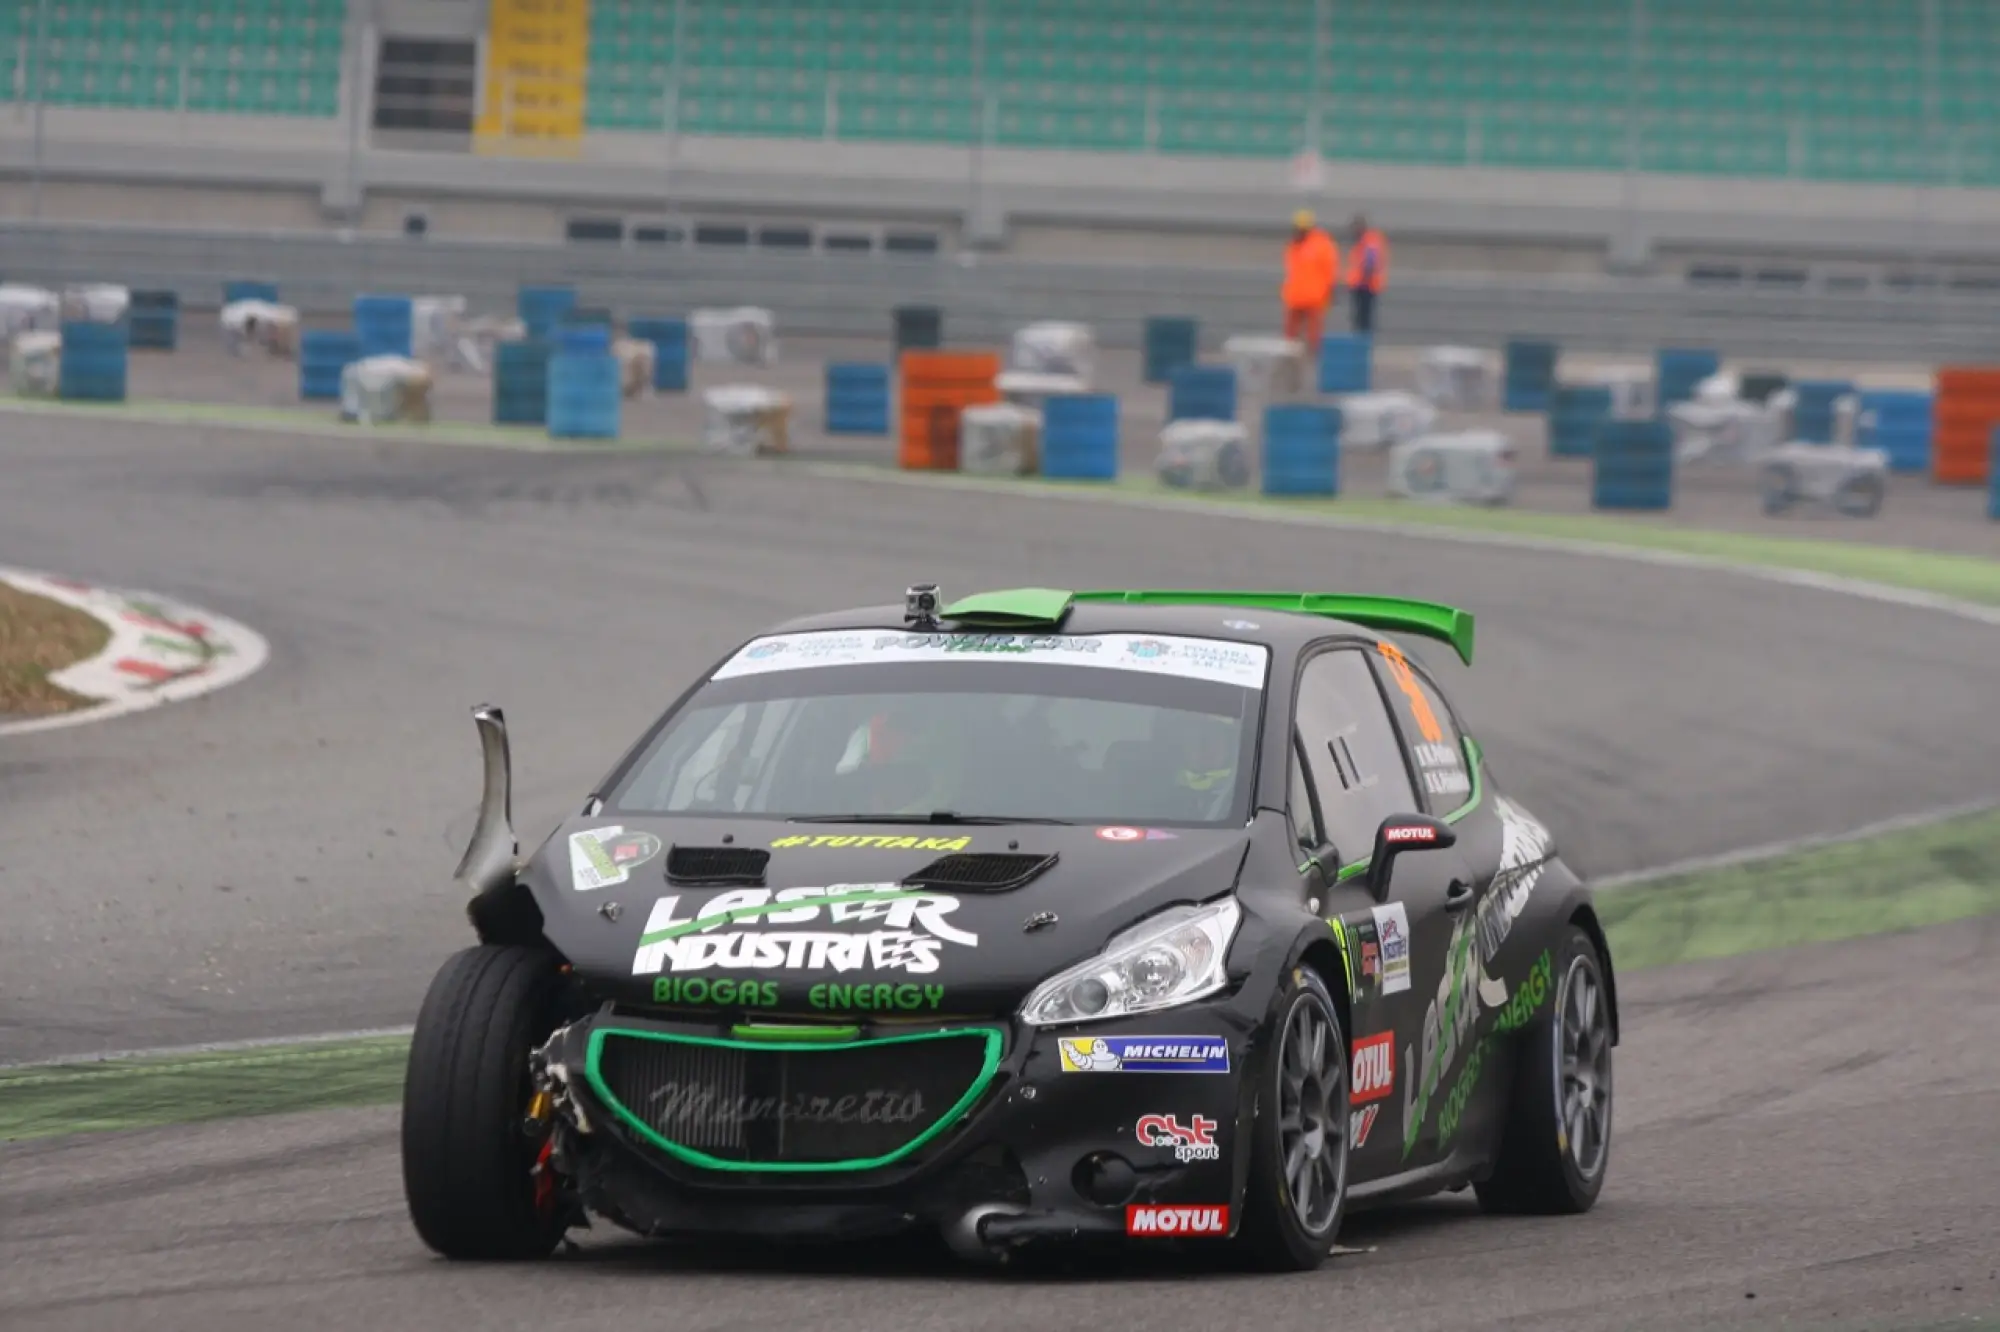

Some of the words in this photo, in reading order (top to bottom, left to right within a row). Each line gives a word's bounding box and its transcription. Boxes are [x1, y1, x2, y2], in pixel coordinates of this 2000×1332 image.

[1387, 828, 1434, 839] MOTUL
[641, 883, 979, 947] LASER
[632, 931, 942, 975] INDUSTRIES
[653, 976, 779, 1006] BIOGAS
[807, 982, 944, 1010] ENERGY
[1124, 1044, 1226, 1059] MICHELIN
[1352, 1042, 1392, 1094] OTUL
[1175, 1146, 1219, 1162] sport
[1133, 1209, 1222, 1232] MOTUL
